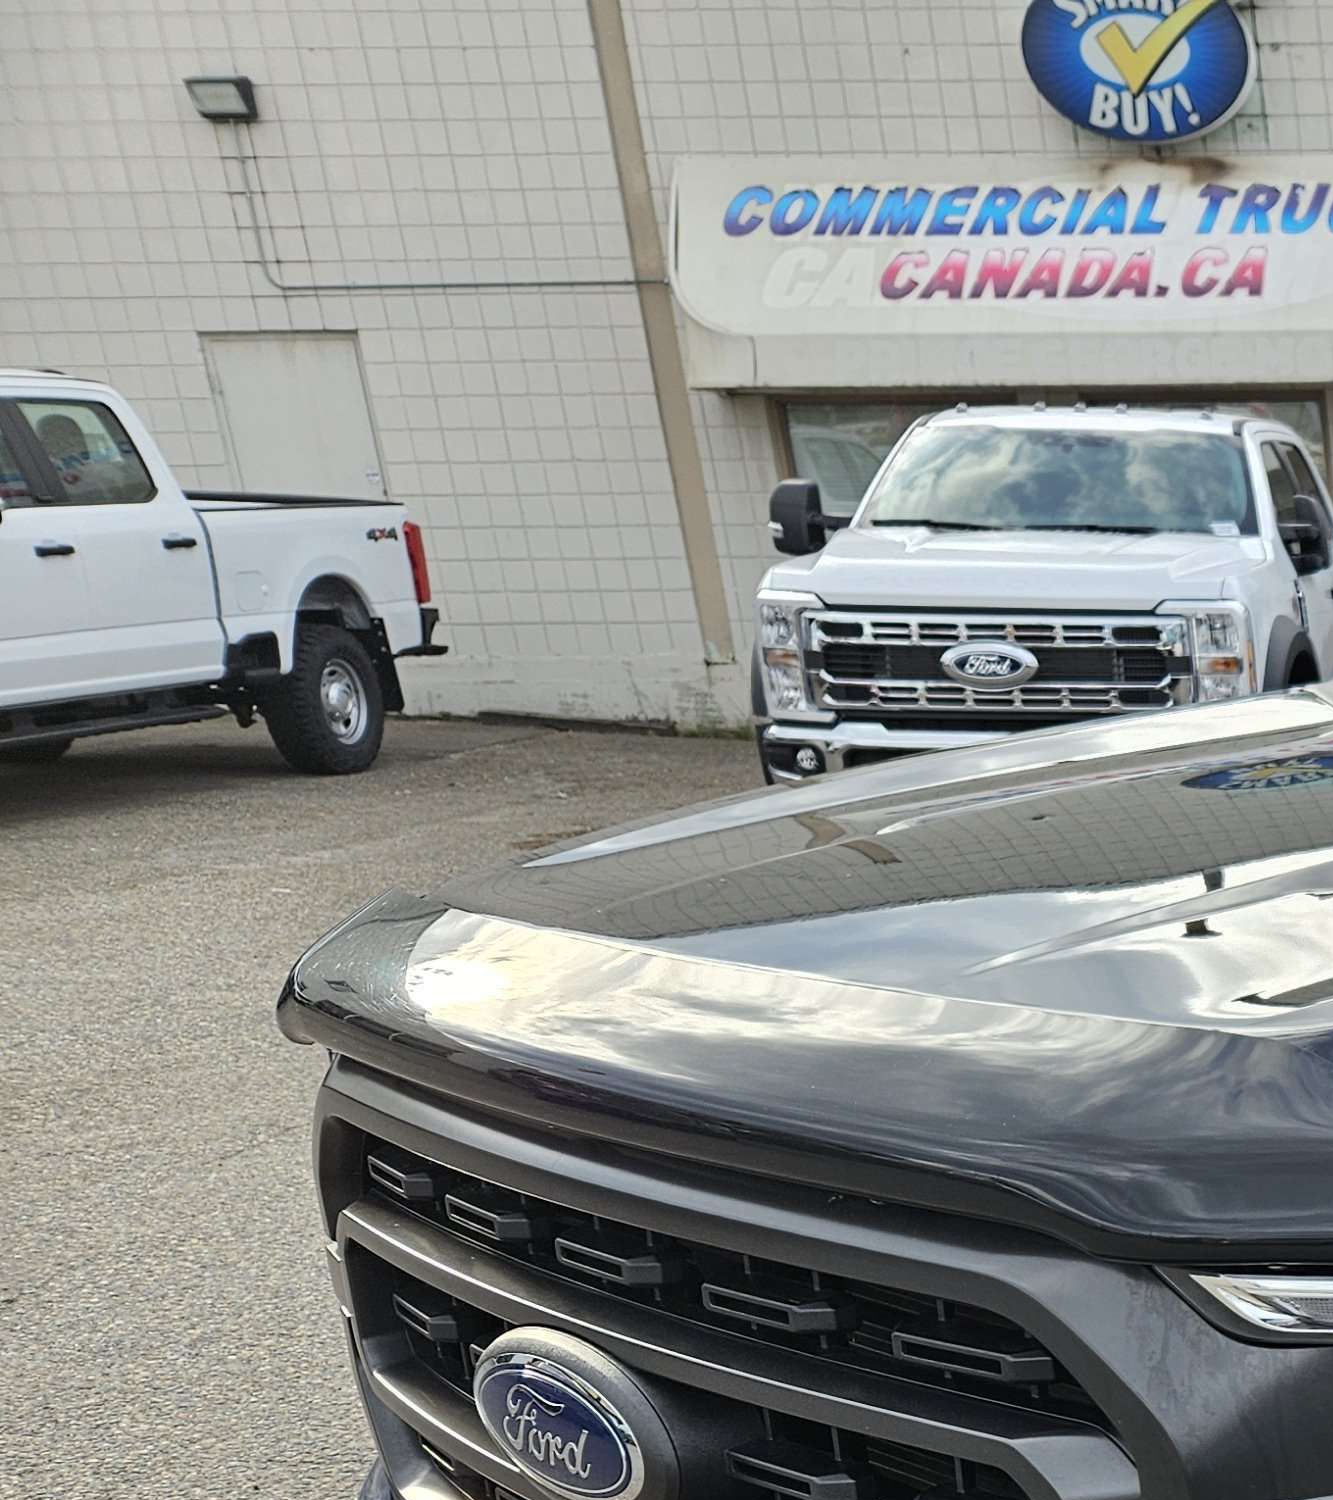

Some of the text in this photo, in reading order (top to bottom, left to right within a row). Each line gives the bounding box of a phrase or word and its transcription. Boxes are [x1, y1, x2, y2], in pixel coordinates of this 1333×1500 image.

[1089, 82, 1201, 136] BUY!
[722, 183, 1167, 237] COMMERCIAL
[879, 245, 1268, 300] CANADA.CA
[963, 654, 1012, 676] Ford
[502, 1383, 592, 1480] Ford
